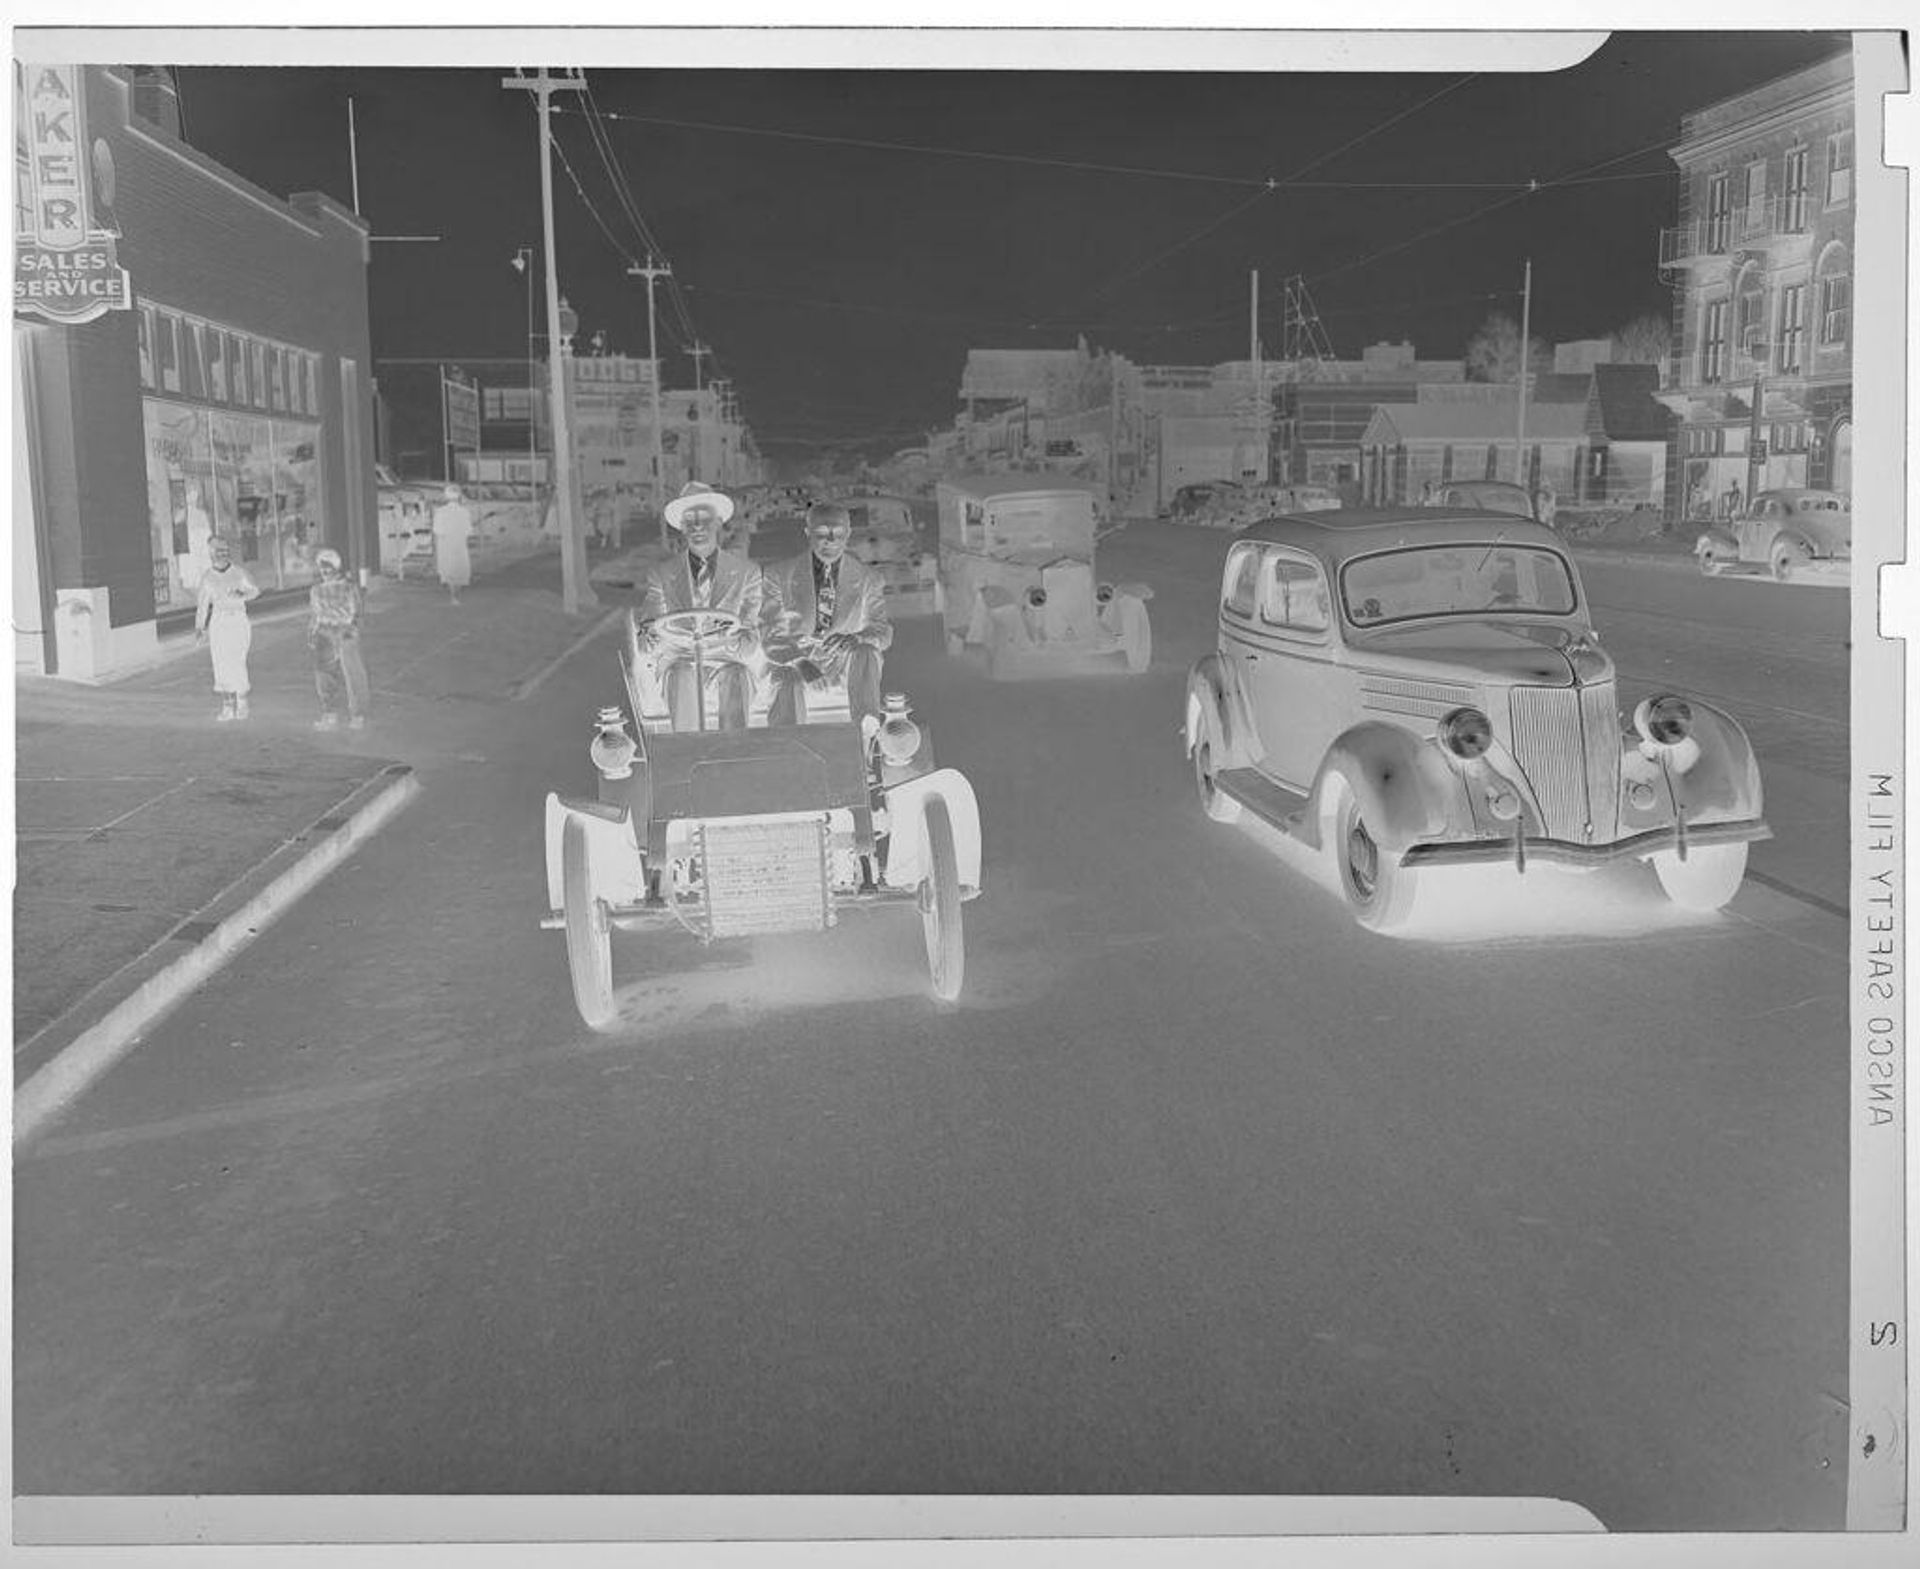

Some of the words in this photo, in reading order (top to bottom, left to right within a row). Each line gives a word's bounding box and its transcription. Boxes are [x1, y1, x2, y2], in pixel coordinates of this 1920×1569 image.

[20, 253, 106, 271] SALES
[46, 270, 82, 279] AND
[15, 279, 121, 297] SERVICE
